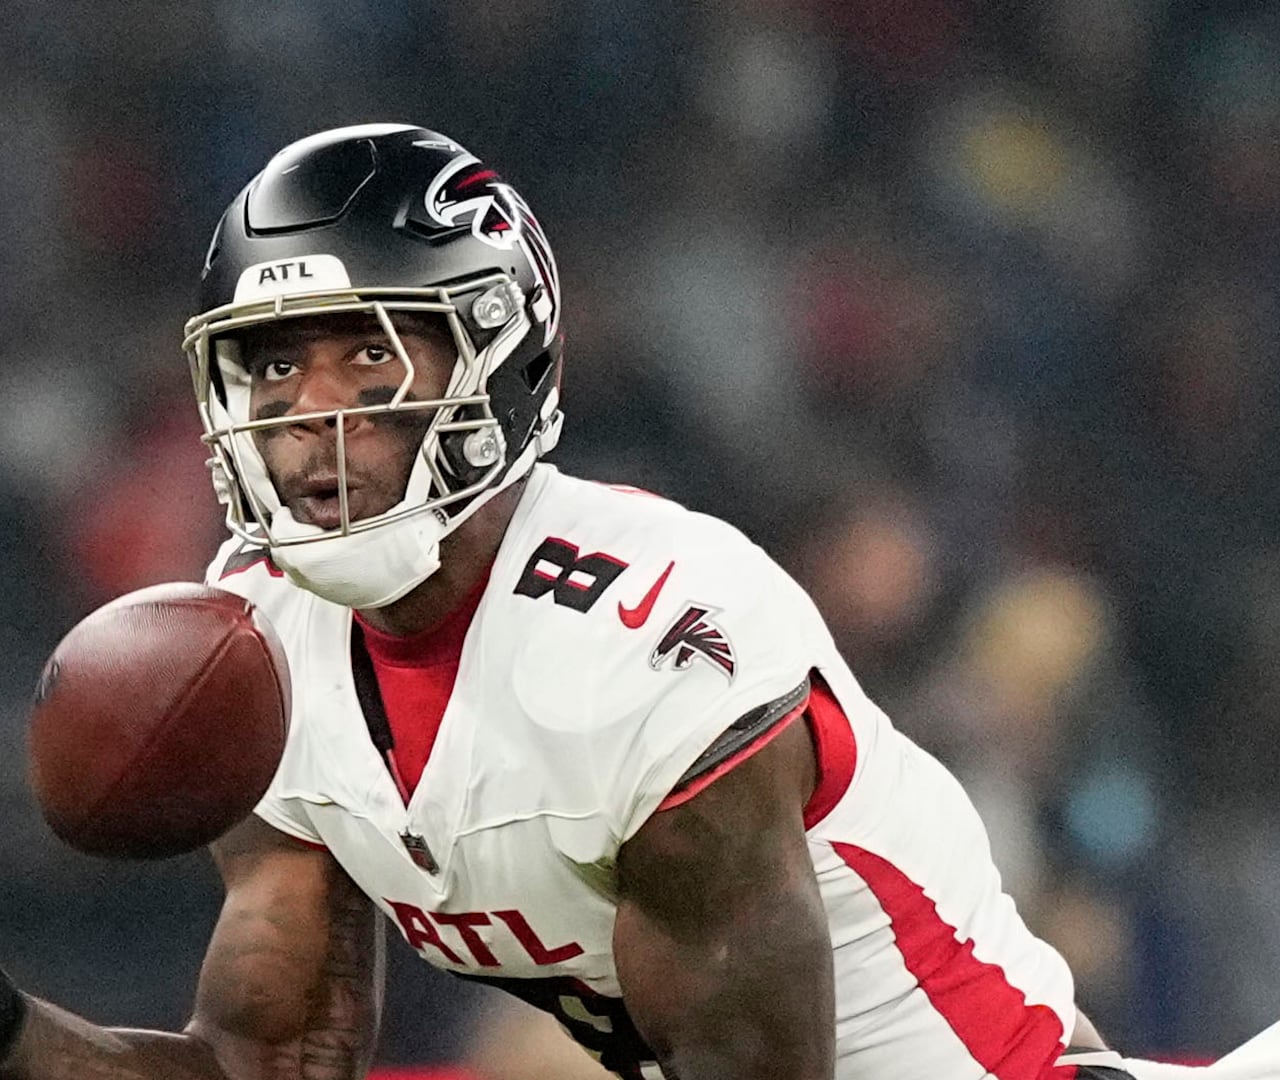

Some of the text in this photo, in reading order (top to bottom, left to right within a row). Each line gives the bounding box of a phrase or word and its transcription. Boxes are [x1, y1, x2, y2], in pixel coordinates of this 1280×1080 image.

[258, 261, 313, 286] ATL
[512, 535, 630, 615] 8
[381, 896, 585, 967] ATL
